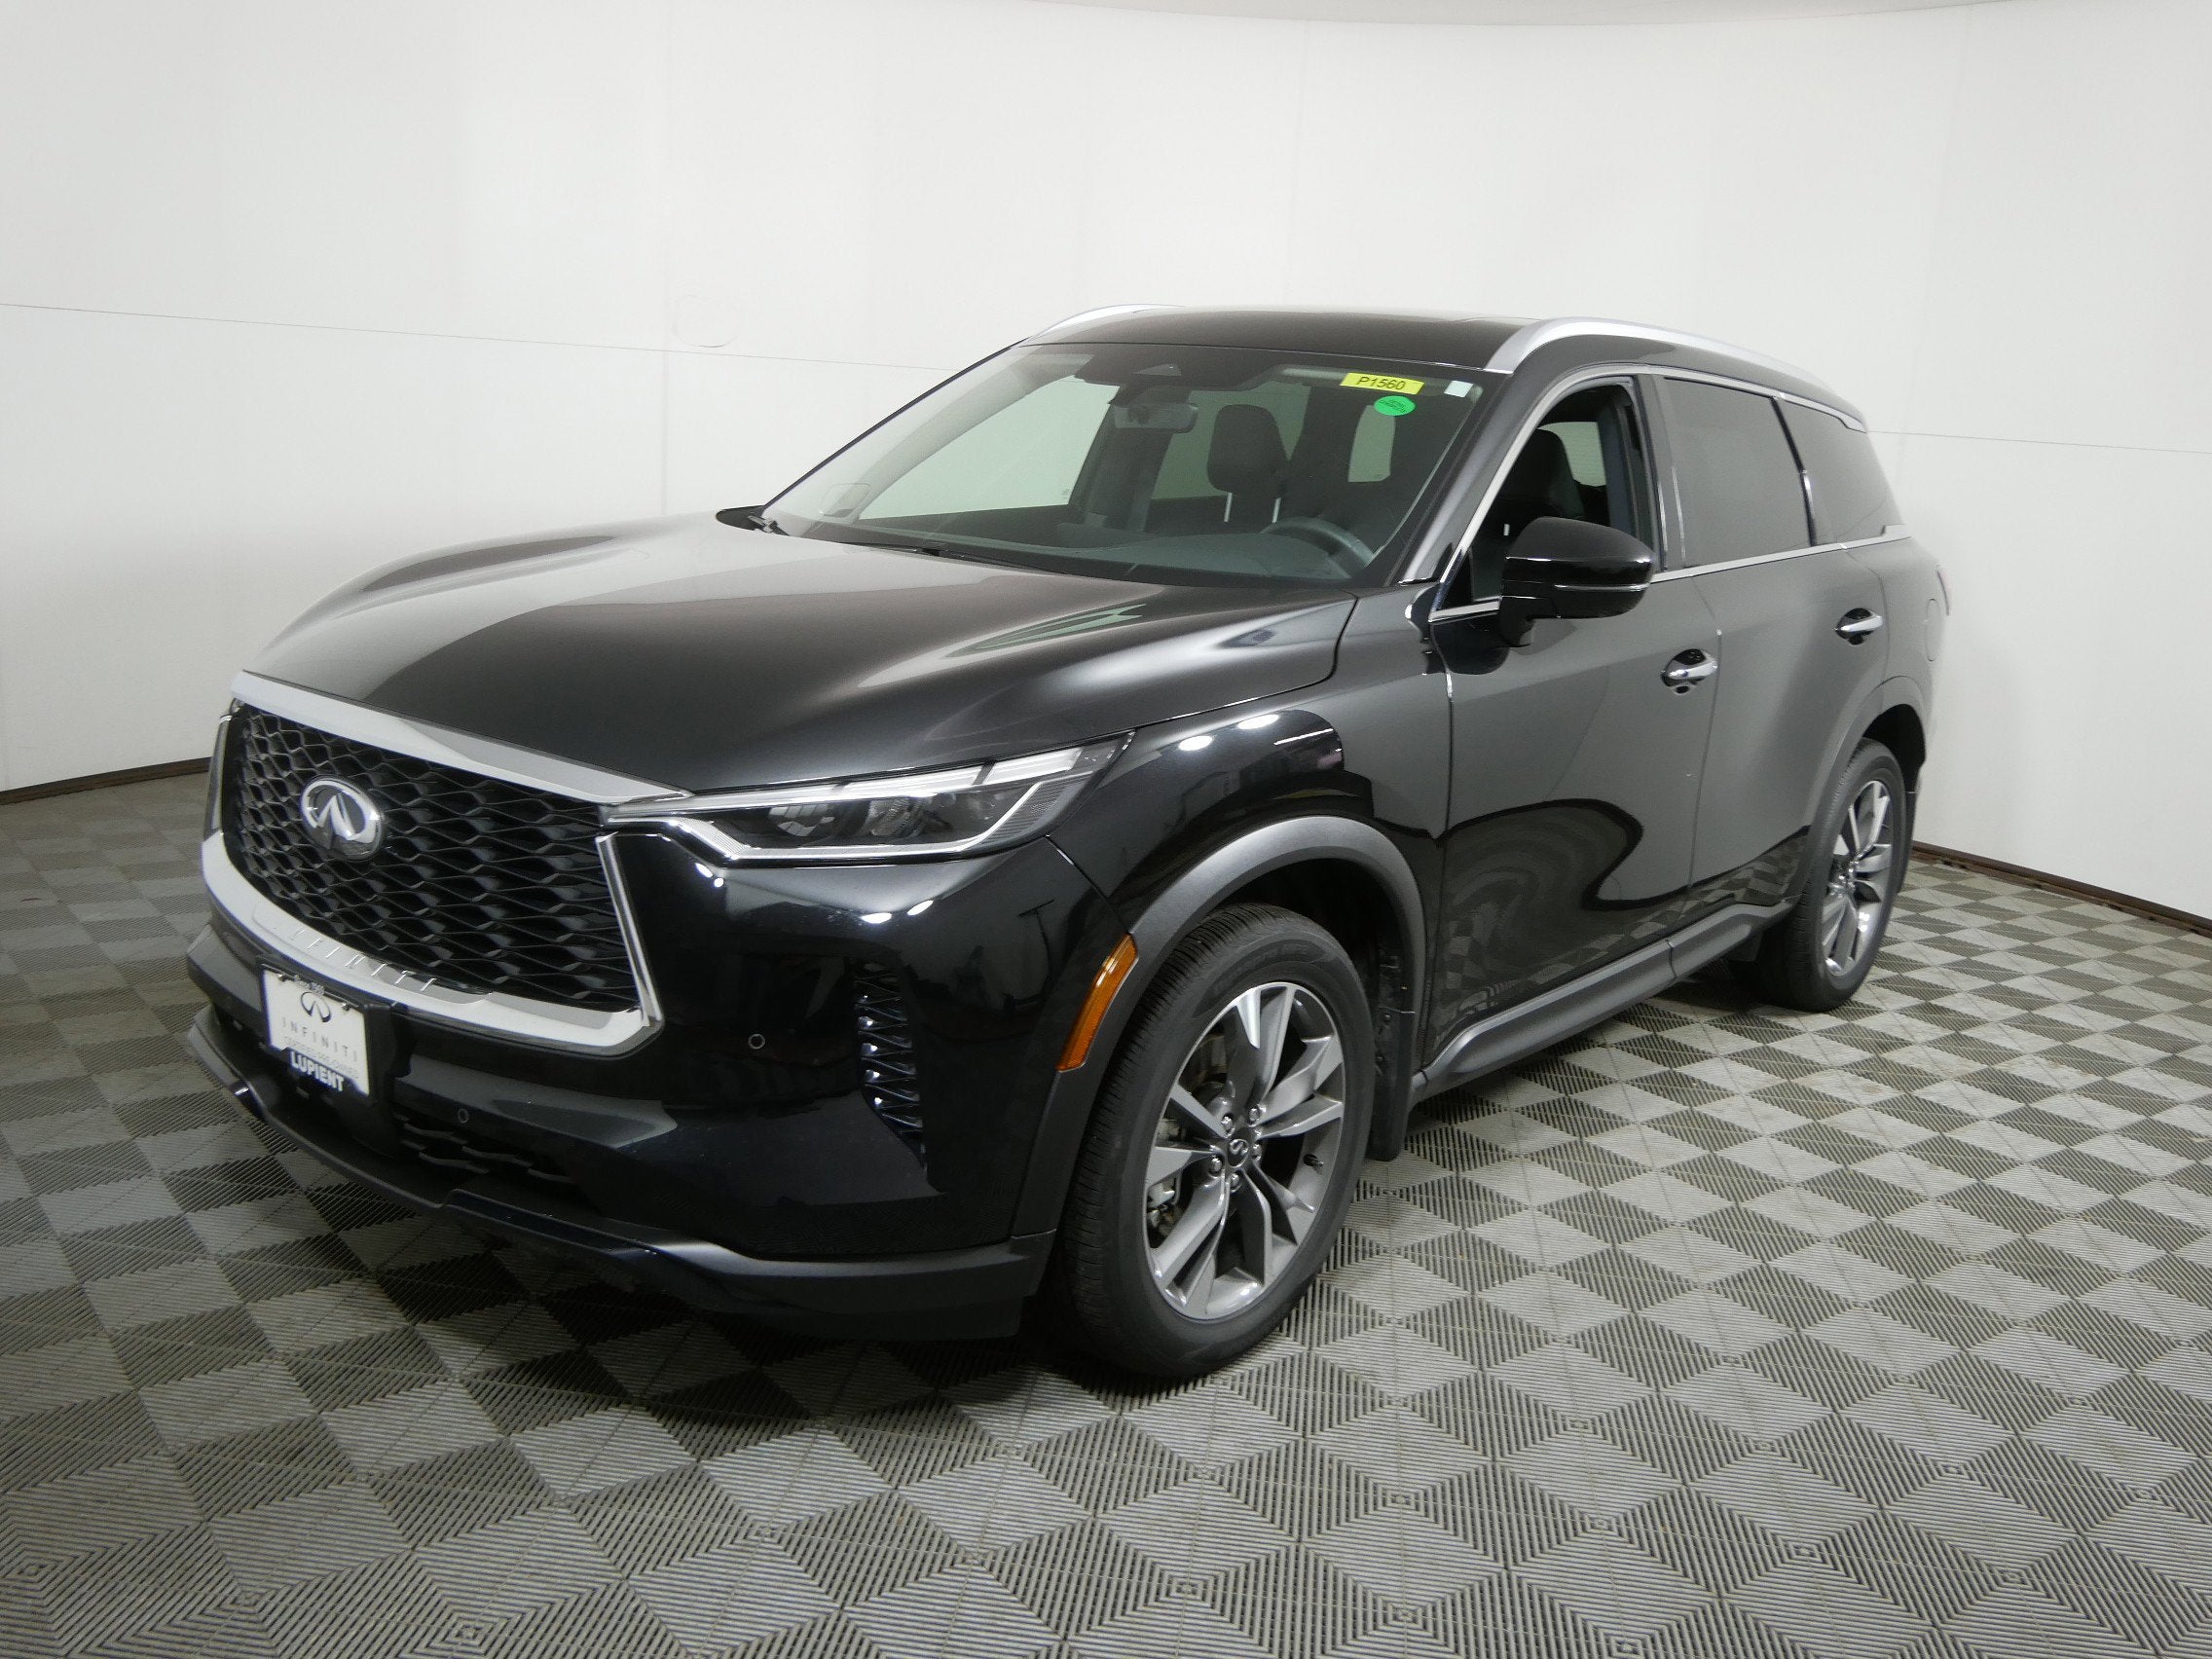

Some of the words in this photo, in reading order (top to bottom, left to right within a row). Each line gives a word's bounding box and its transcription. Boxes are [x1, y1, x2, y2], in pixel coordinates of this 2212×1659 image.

[1356, 376, 1406, 390] P1560
[274, 919, 436, 992] NFINITI
[281, 1016, 358, 1063] INFINITI
[290, 1051, 346, 1091] LUPIENT
